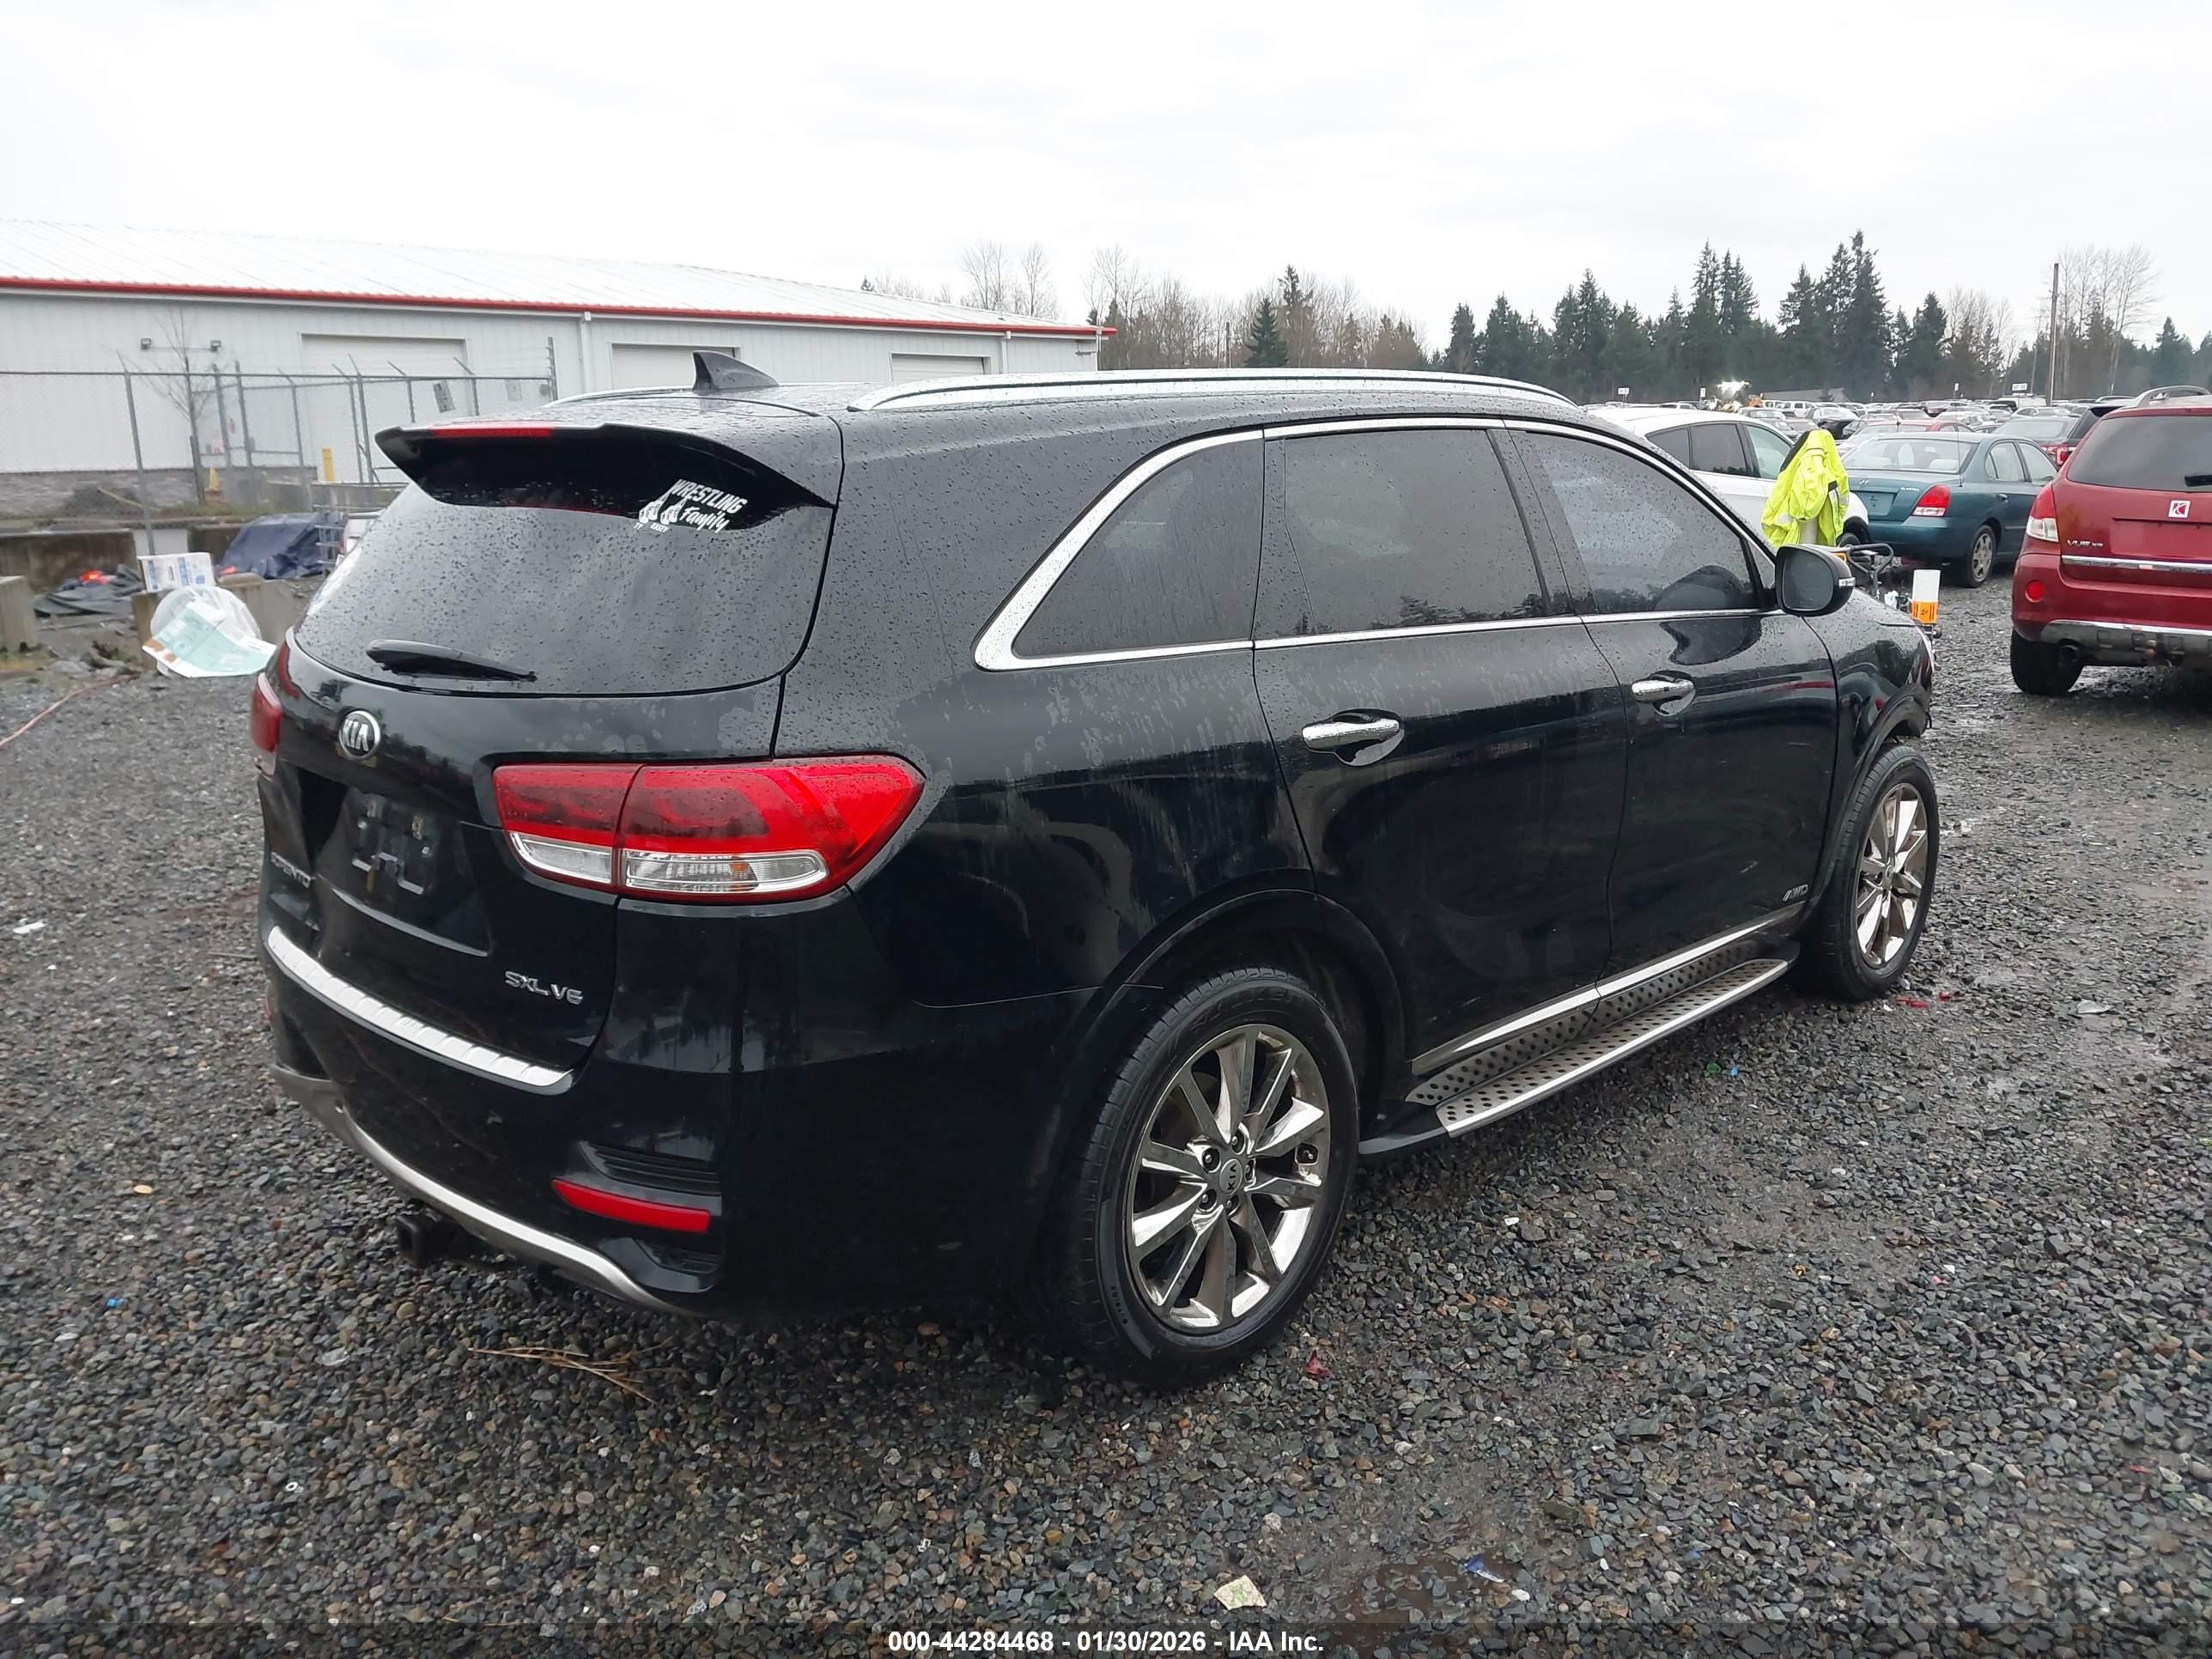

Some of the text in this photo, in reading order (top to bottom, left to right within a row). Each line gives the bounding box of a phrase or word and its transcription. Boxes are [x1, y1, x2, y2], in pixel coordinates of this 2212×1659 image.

[671, 478, 748, 514] WRESTLING
[679, 505, 730, 534] Family
[343, 719, 368, 751] KIA
[1783, 884, 1808, 902] AWD
[504, 970, 583, 1006] SXL V6
[1227, 1163, 1237, 1190] KIA
